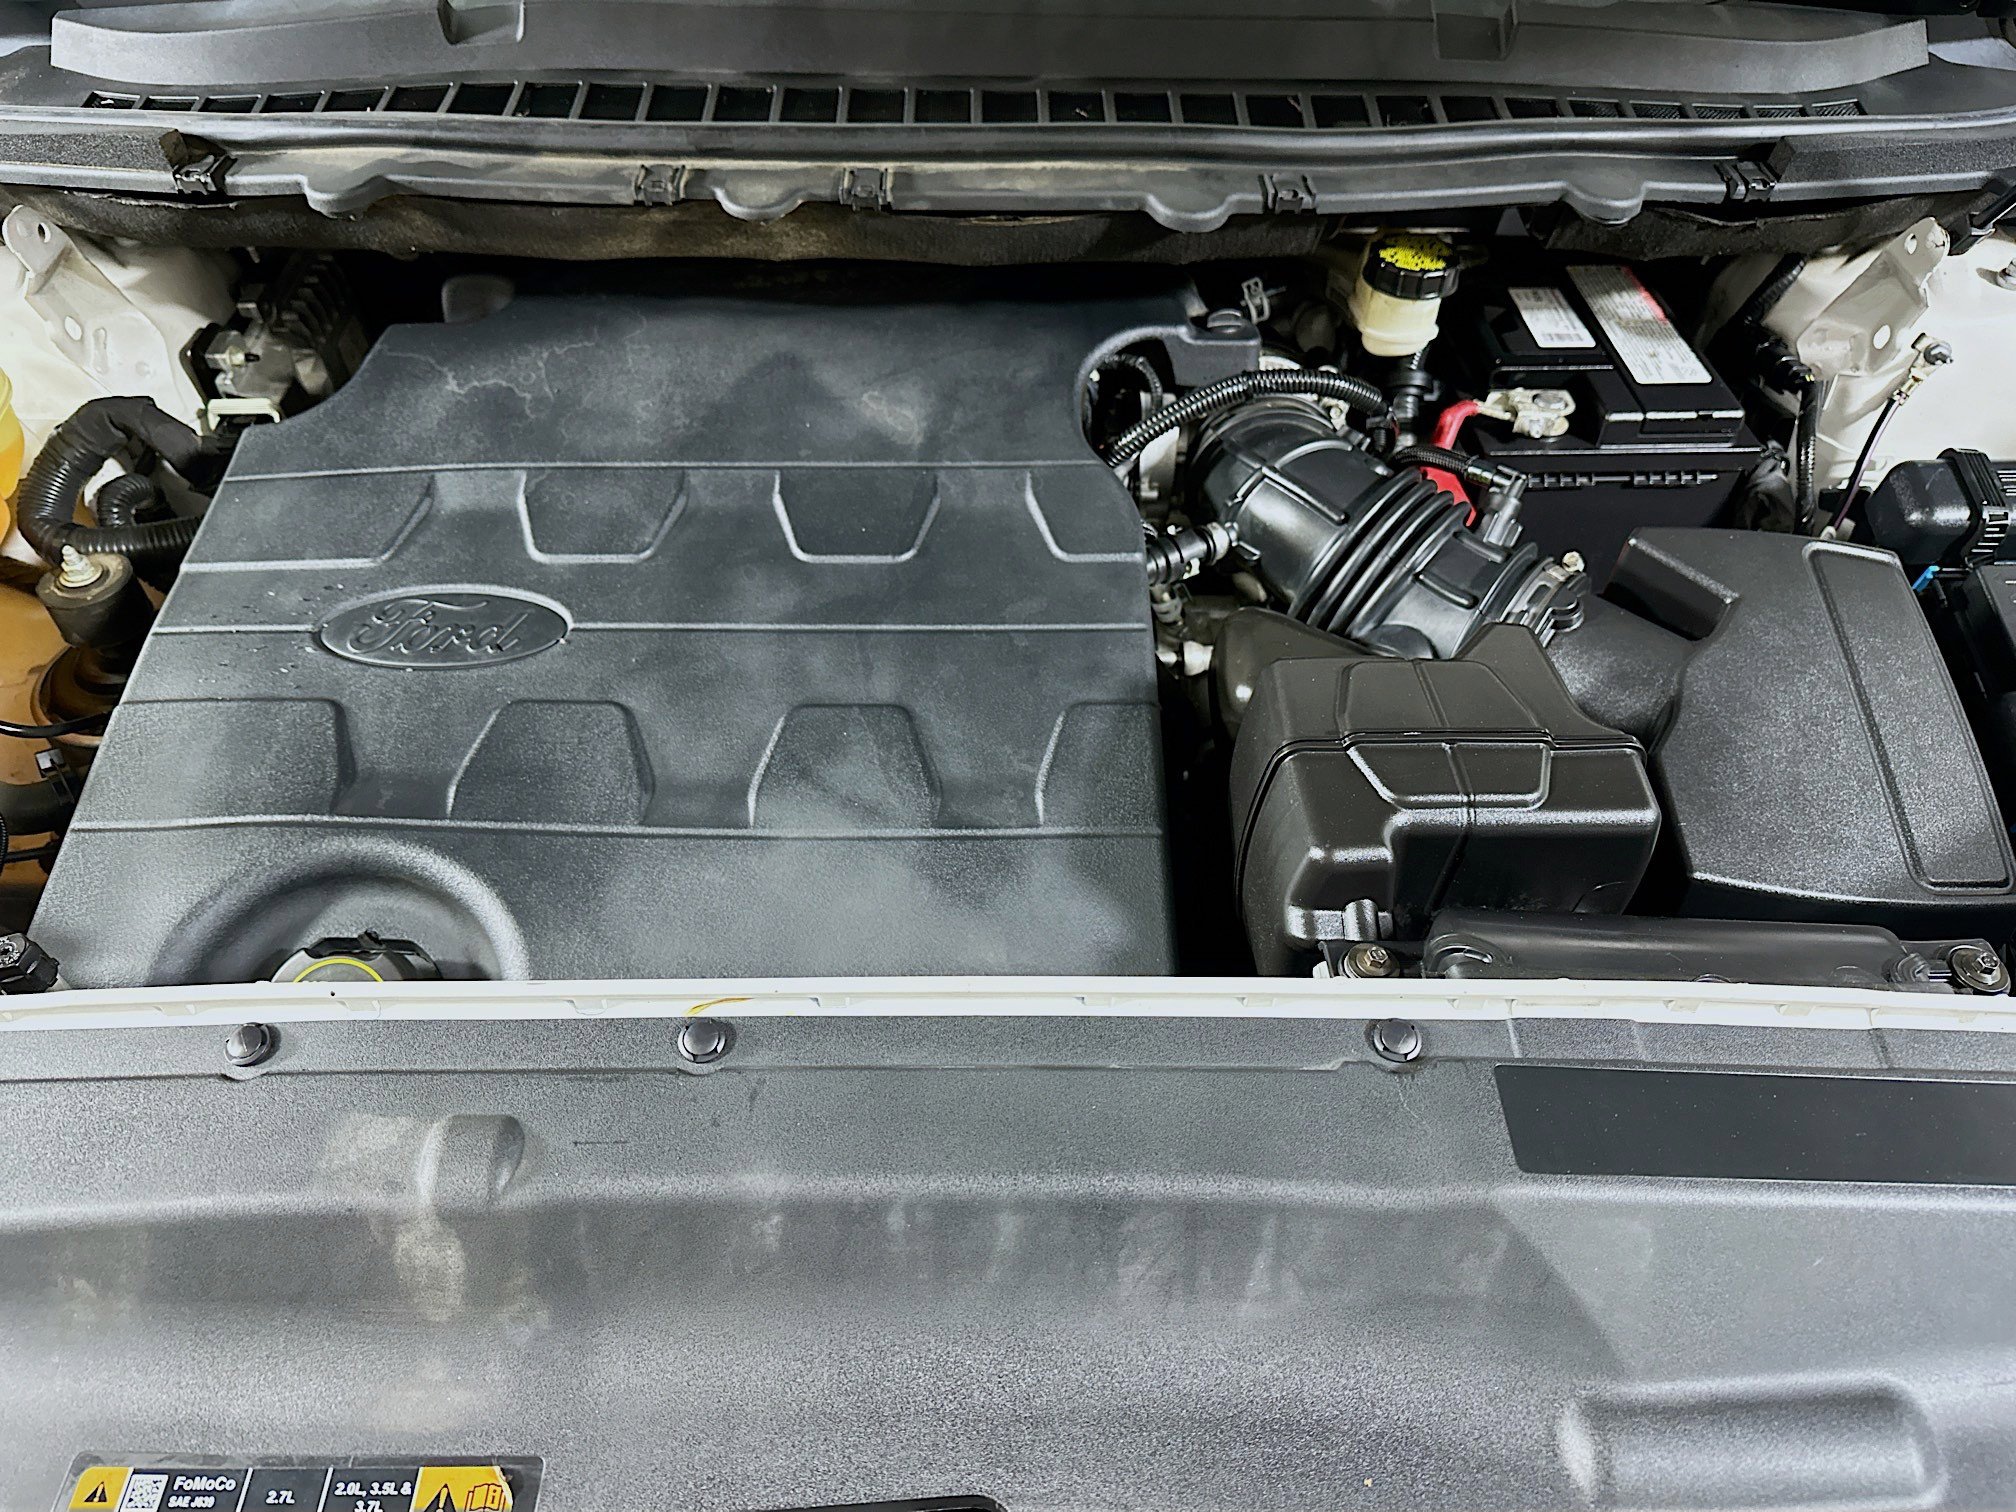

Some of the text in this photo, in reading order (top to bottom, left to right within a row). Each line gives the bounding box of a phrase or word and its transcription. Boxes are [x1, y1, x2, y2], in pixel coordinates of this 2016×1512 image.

[347, 599, 528, 654] Ford
[173, 1475, 237, 1491] FoMoCo
[369, 1482, 399, 1496] 3.5L
[400, 1481, 412, 1496] &
[167, 1495, 191, 1508] SAE
[265, 1490, 296, 1504] 2.7L
